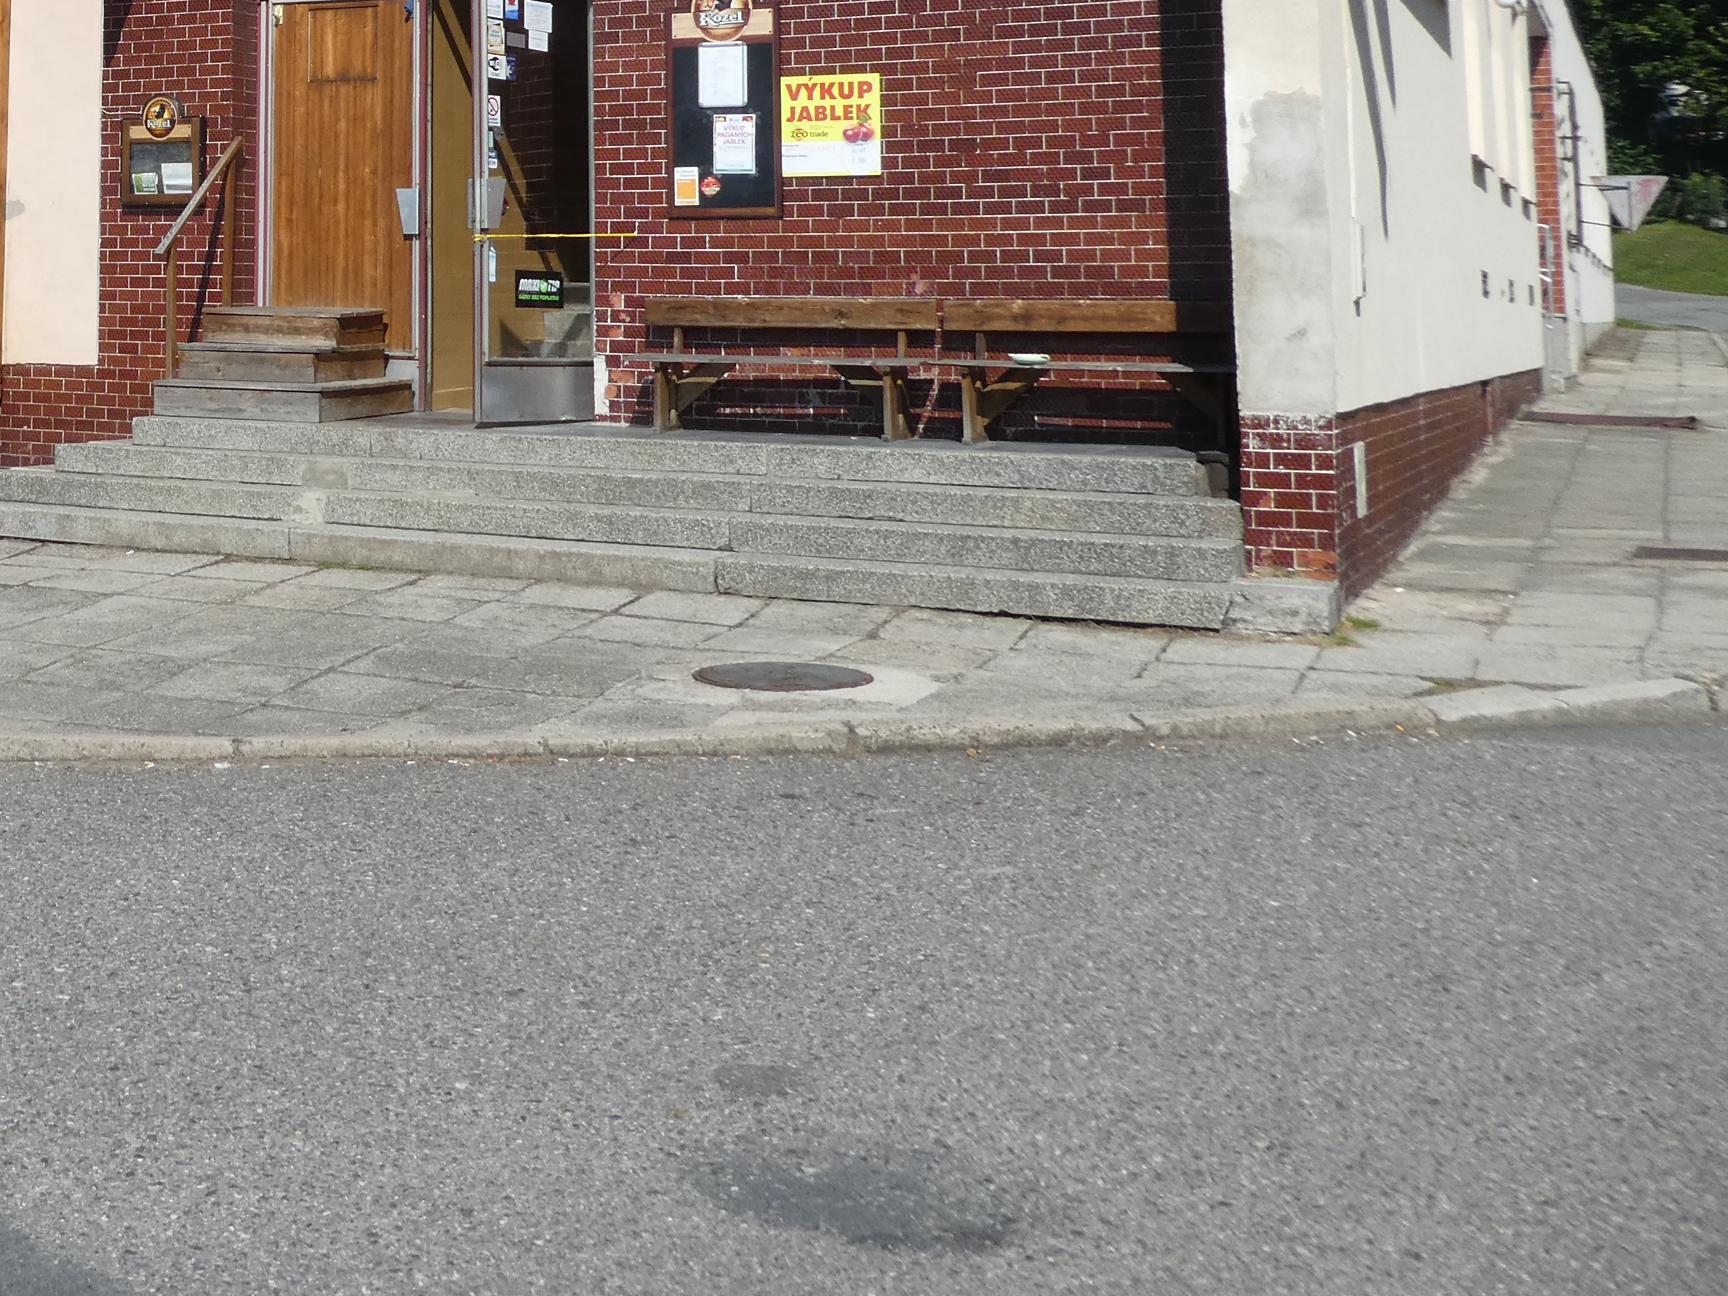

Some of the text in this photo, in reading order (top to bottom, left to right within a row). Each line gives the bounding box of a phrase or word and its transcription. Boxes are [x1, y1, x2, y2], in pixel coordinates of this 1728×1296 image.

[699, 11, 745, 27] Kozel
[784, 77, 873, 101] VÝKUP
[786, 104, 872, 123] JABLEK
[809, 130, 830, 138] trade
